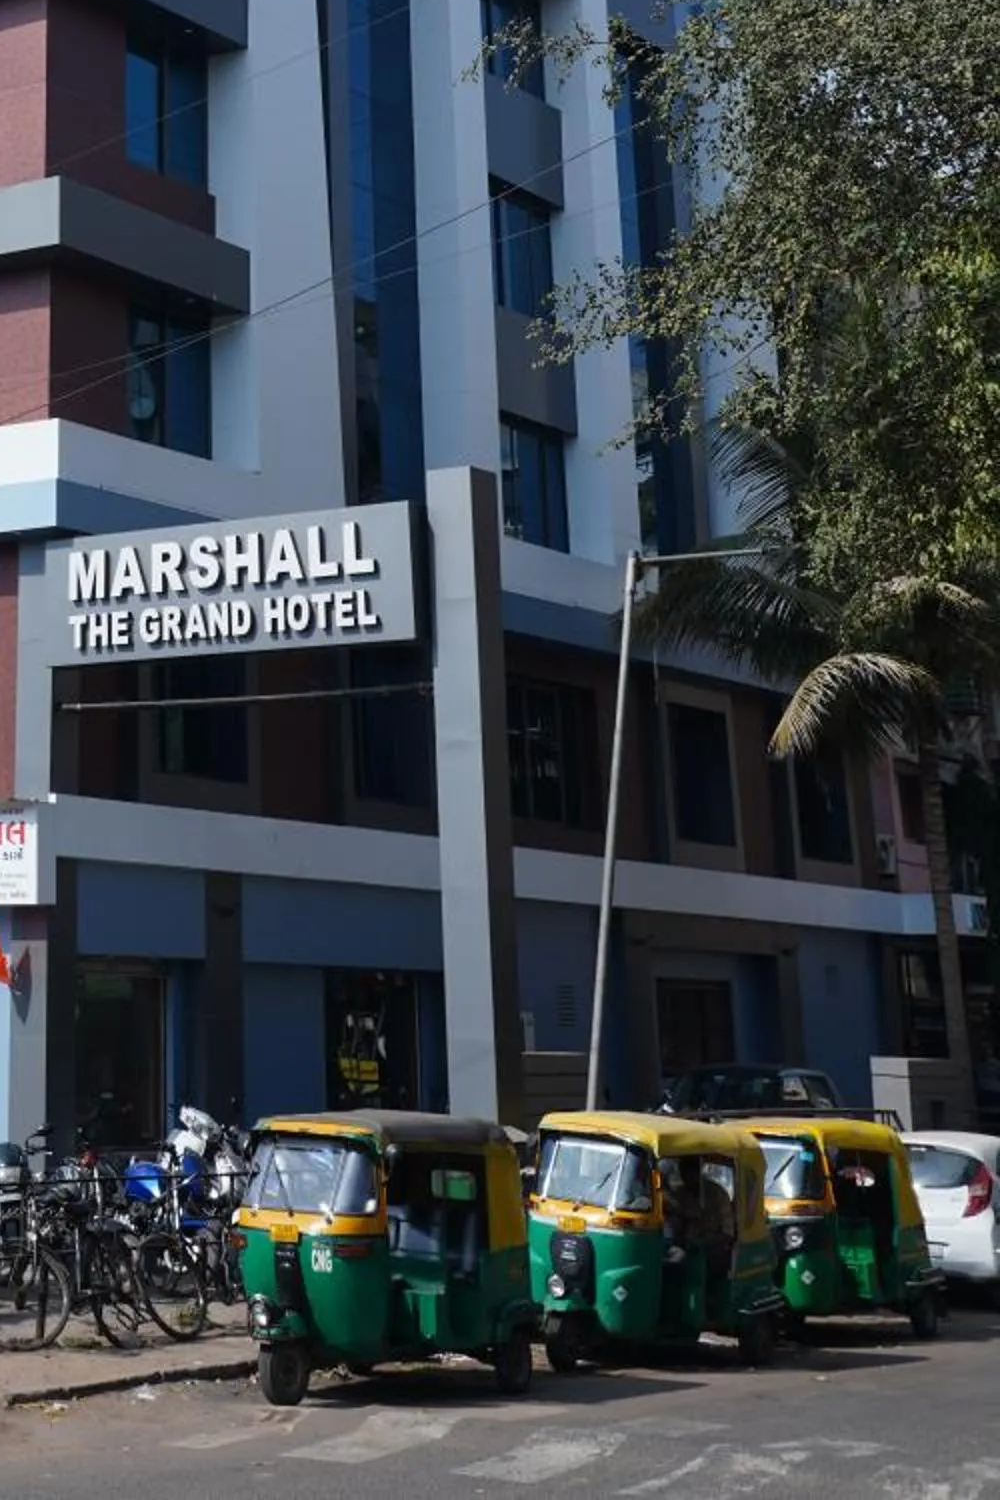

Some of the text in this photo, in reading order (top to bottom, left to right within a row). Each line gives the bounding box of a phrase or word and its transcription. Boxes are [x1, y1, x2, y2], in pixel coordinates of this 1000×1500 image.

[68, 521, 377, 602] MARSHALL
[68, 588, 378, 650] THE GRAND HOTEL
[311, 1247, 333, 1273] CNG
